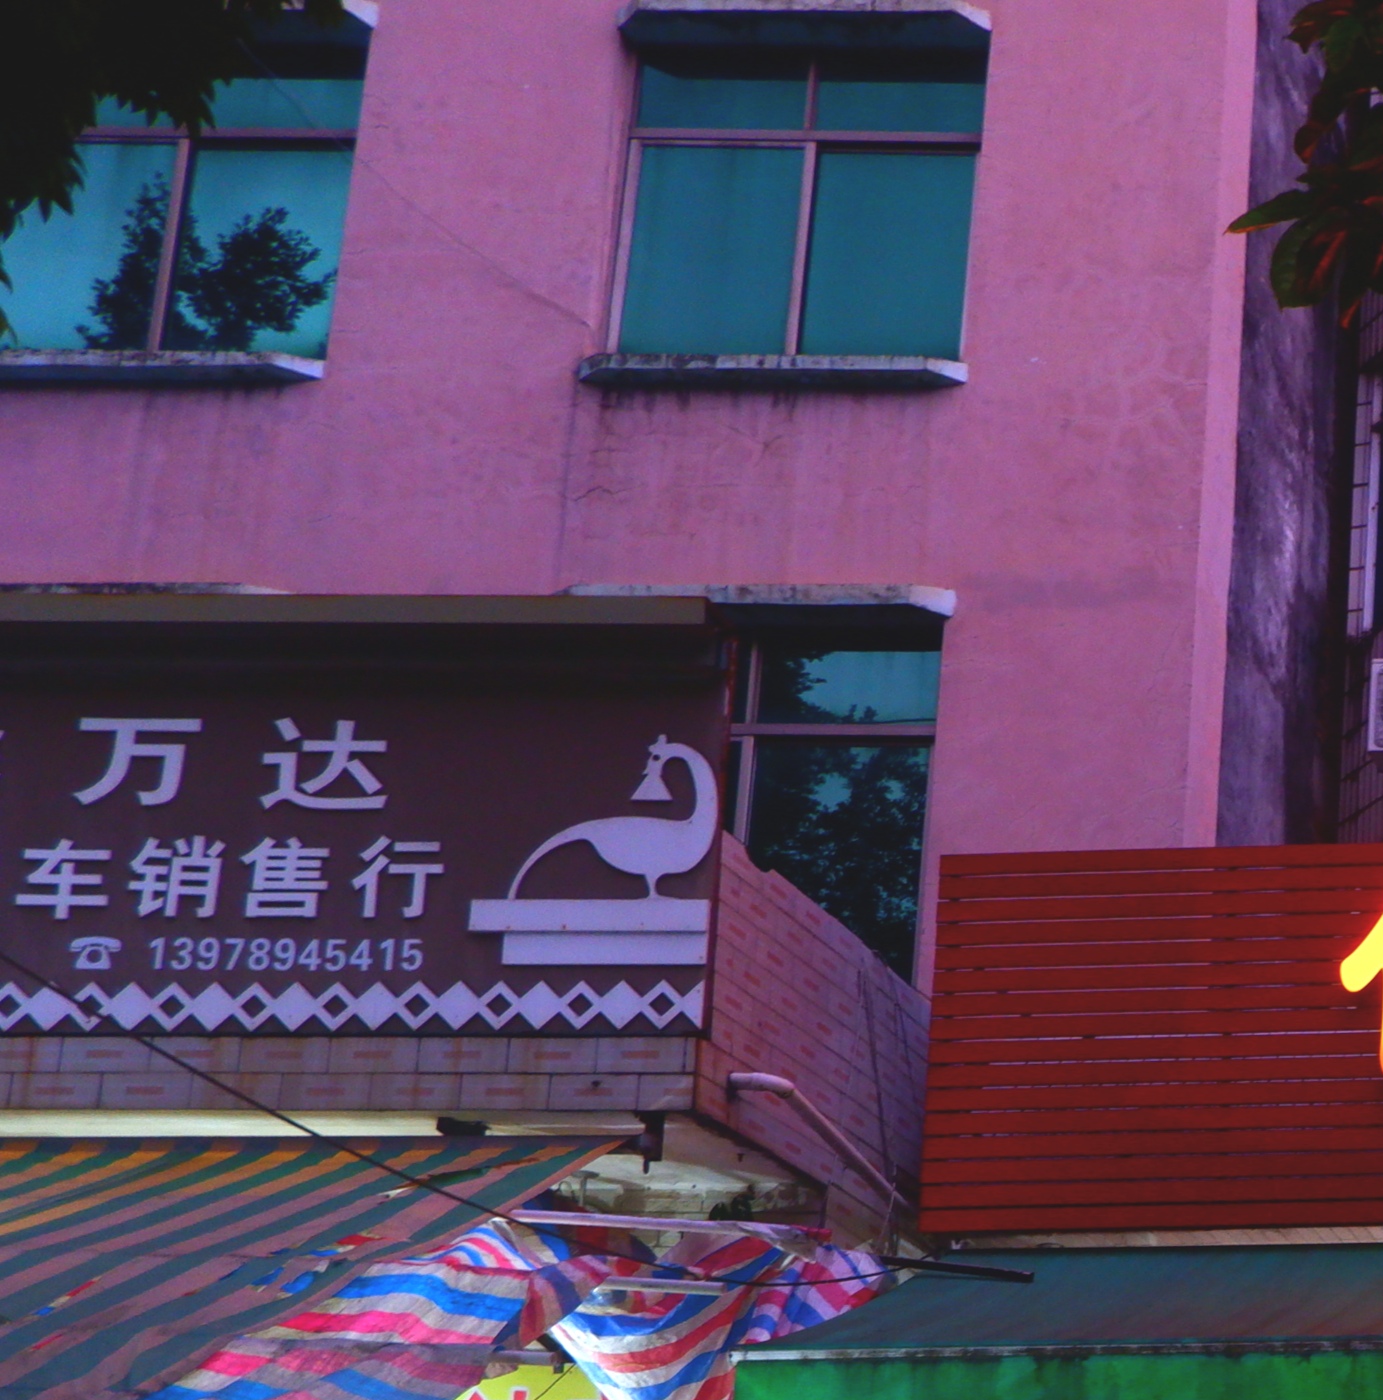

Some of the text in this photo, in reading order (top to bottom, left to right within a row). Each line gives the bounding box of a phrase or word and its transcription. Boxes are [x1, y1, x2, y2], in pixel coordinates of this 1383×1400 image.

[74, 717, 388, 811] 万达
[14, 835, 445, 920] 车销售行
[148, 936, 424, 972] 13978945415
